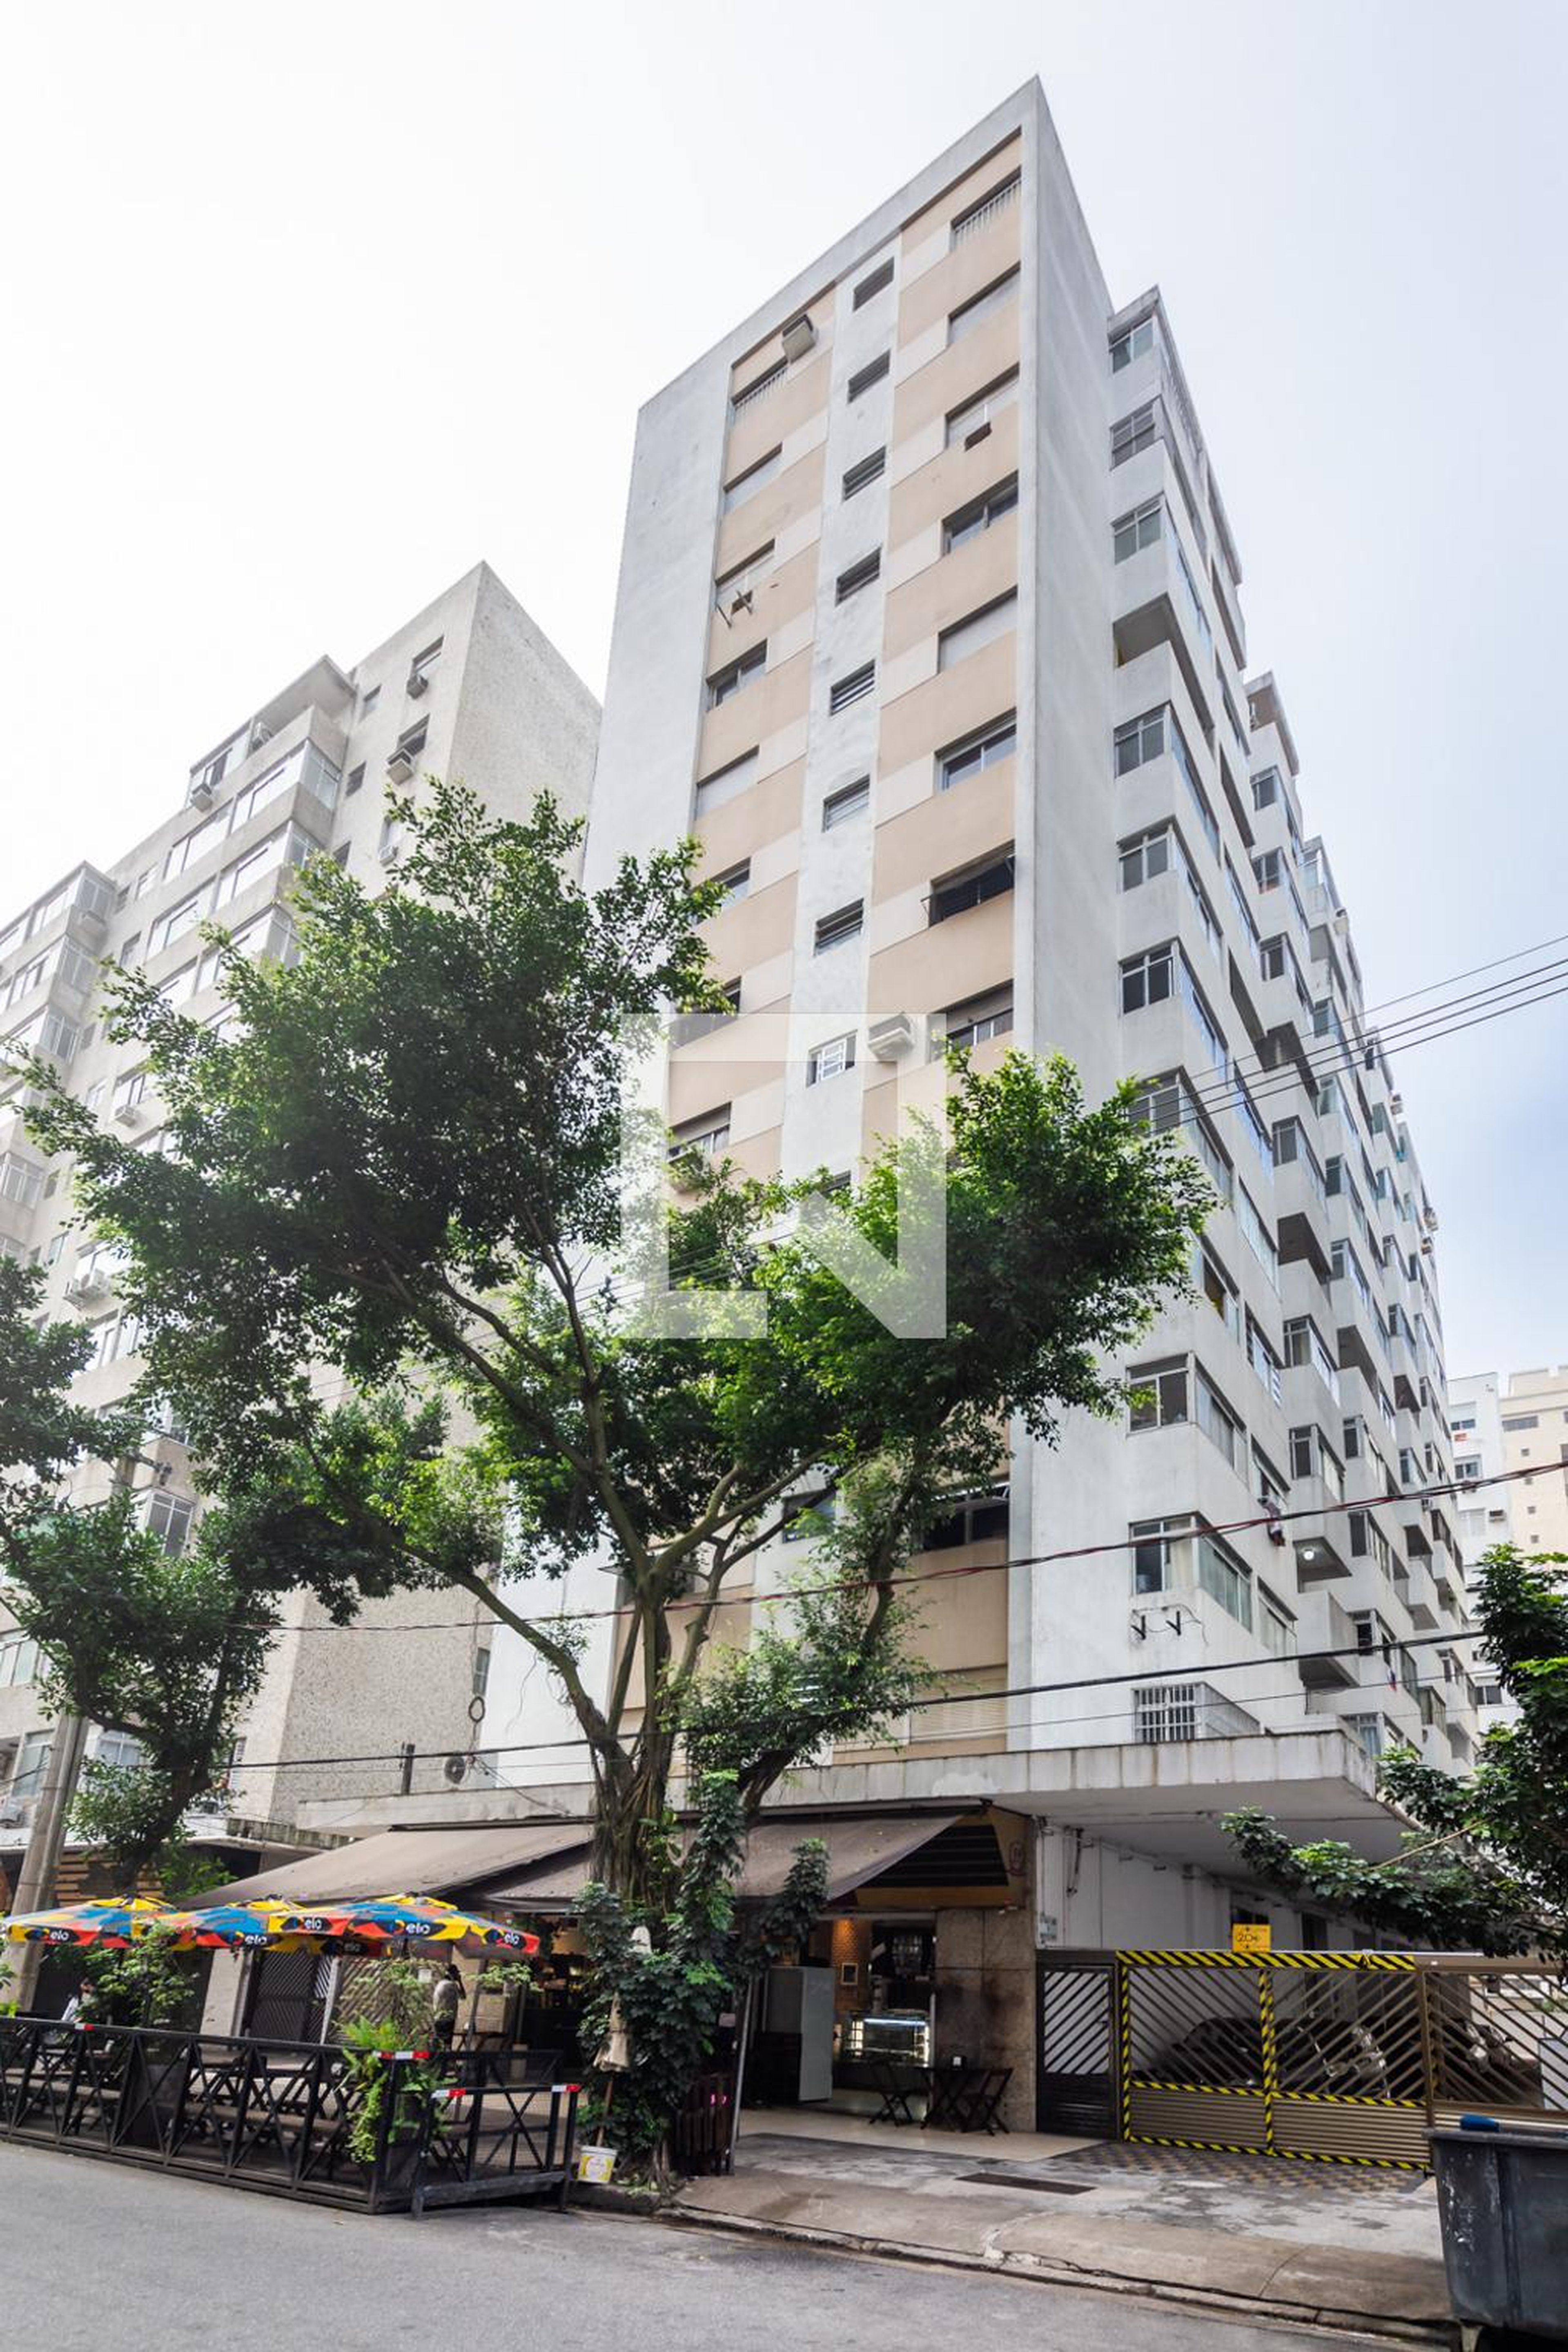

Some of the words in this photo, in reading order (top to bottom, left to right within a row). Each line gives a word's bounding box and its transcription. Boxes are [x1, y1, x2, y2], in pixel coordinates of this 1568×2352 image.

[304, 1917, 322, 1930] elo
[406, 1922, 430, 1934] elo
[50, 1930, 69, 1941] elo
[245, 1935, 267, 1945] elo
[504, 1931, 520, 1945] elo
